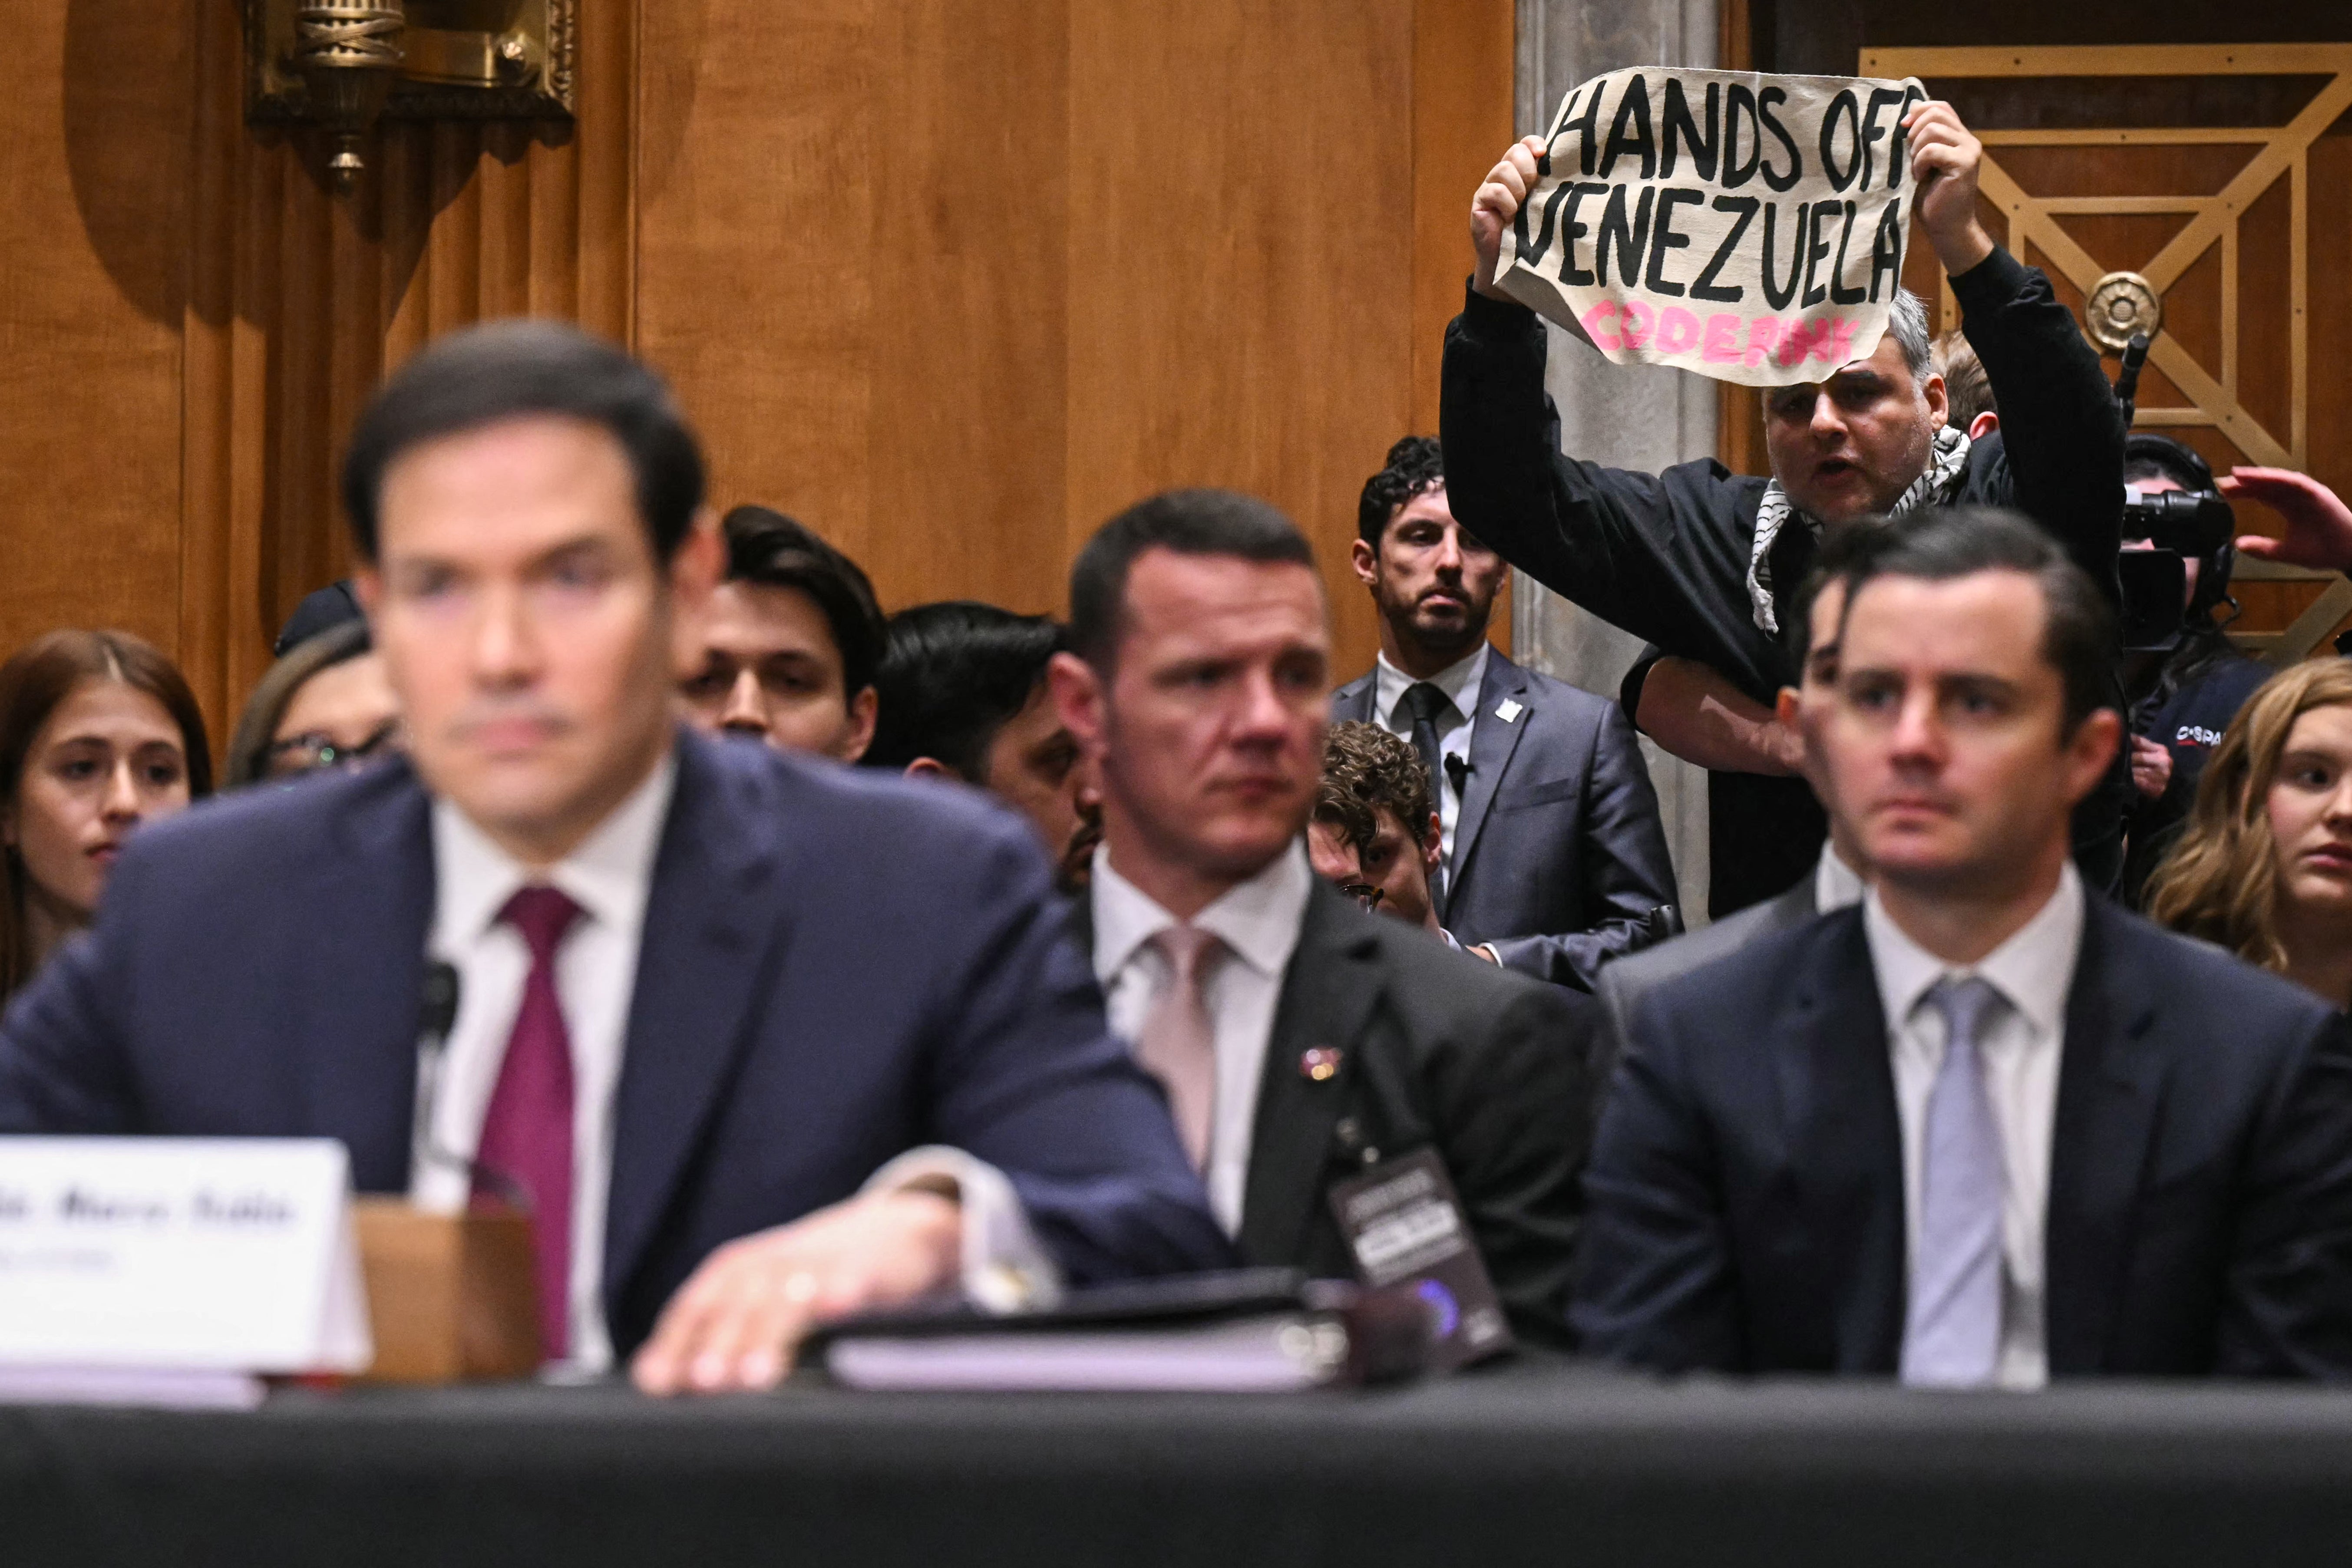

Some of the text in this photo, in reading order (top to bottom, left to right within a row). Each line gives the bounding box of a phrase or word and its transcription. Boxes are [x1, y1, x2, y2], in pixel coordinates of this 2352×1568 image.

[1537, 74, 1802, 192] HANDS
[1514, 180, 1901, 310] VENEZUELA
[1580, 299, 1860, 368] CODEPINK
